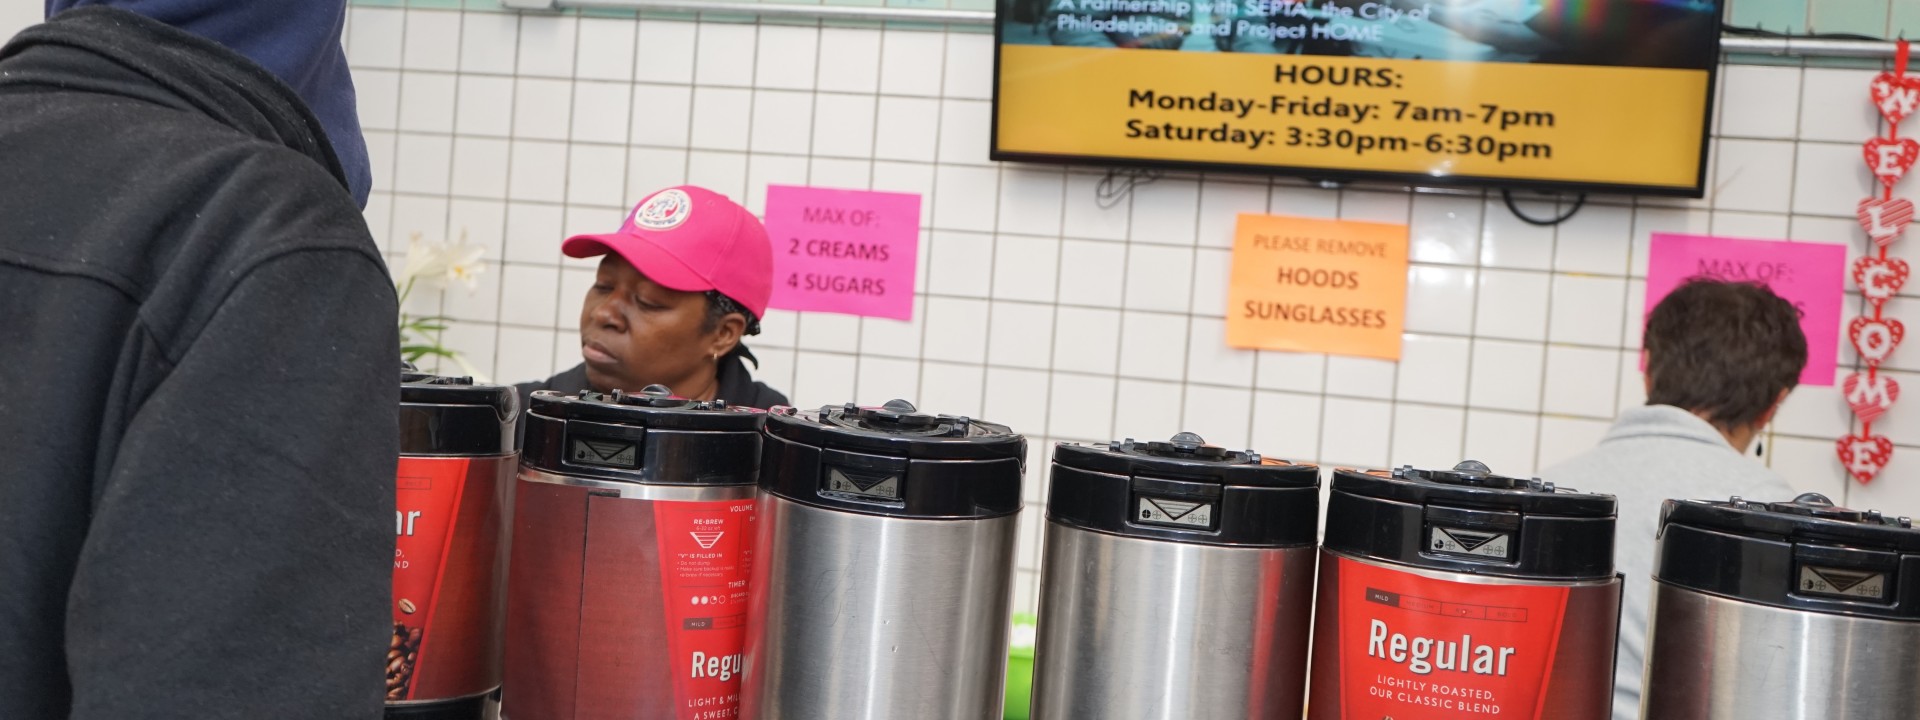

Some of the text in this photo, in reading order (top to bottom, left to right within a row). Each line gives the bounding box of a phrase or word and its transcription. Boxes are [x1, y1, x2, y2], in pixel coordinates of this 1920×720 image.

[1080, 0, 1191, 17] Partnership
[1196, 0, 1238, 14] with
[1244, 0, 1313, 20] SEPTA,
[1321, 1, 1354, 17] the
[1359, 2, 1403, 23] City
[1408, 3, 1431, 21] of
[1057, 14, 1383, 42] Philadelphia, and Project HOME
[1274, 64, 1403, 89] HOURS:
[1129, 88, 1555, 131] Monday-Friday: 7am-7pm
[1126, 119, 1552, 162] Saturday: 3:30pm-6:30pm
[802, 207, 880, 228] MAX OF:
[788, 238, 889, 262] 2 CREAMS
[1253, 234, 1387, 258] PLEASE REMOVE
[1277, 266, 1359, 290] HOODS
[1698, 258, 1795, 283] MAX OF:
[787, 272, 885, 296] 4 SUGARS
[1244, 300, 1386, 329] SUNGLASSES
[730, 504, 753, 513] VOLUME
[728, 580, 745, 588] TIMER
[1375, 593, 1389, 602] MILD
[1368, 618, 1515, 676] Regular
[691, 651, 741, 681] Regu
[1377, 674, 1495, 702] LIGHTLY ROASTED,
[688, 694, 739, 707] LIGHT & MIL
[1370, 686, 1500, 715] OUR CLASSIC BLEND
[704, 708, 731, 720] SWEET,
